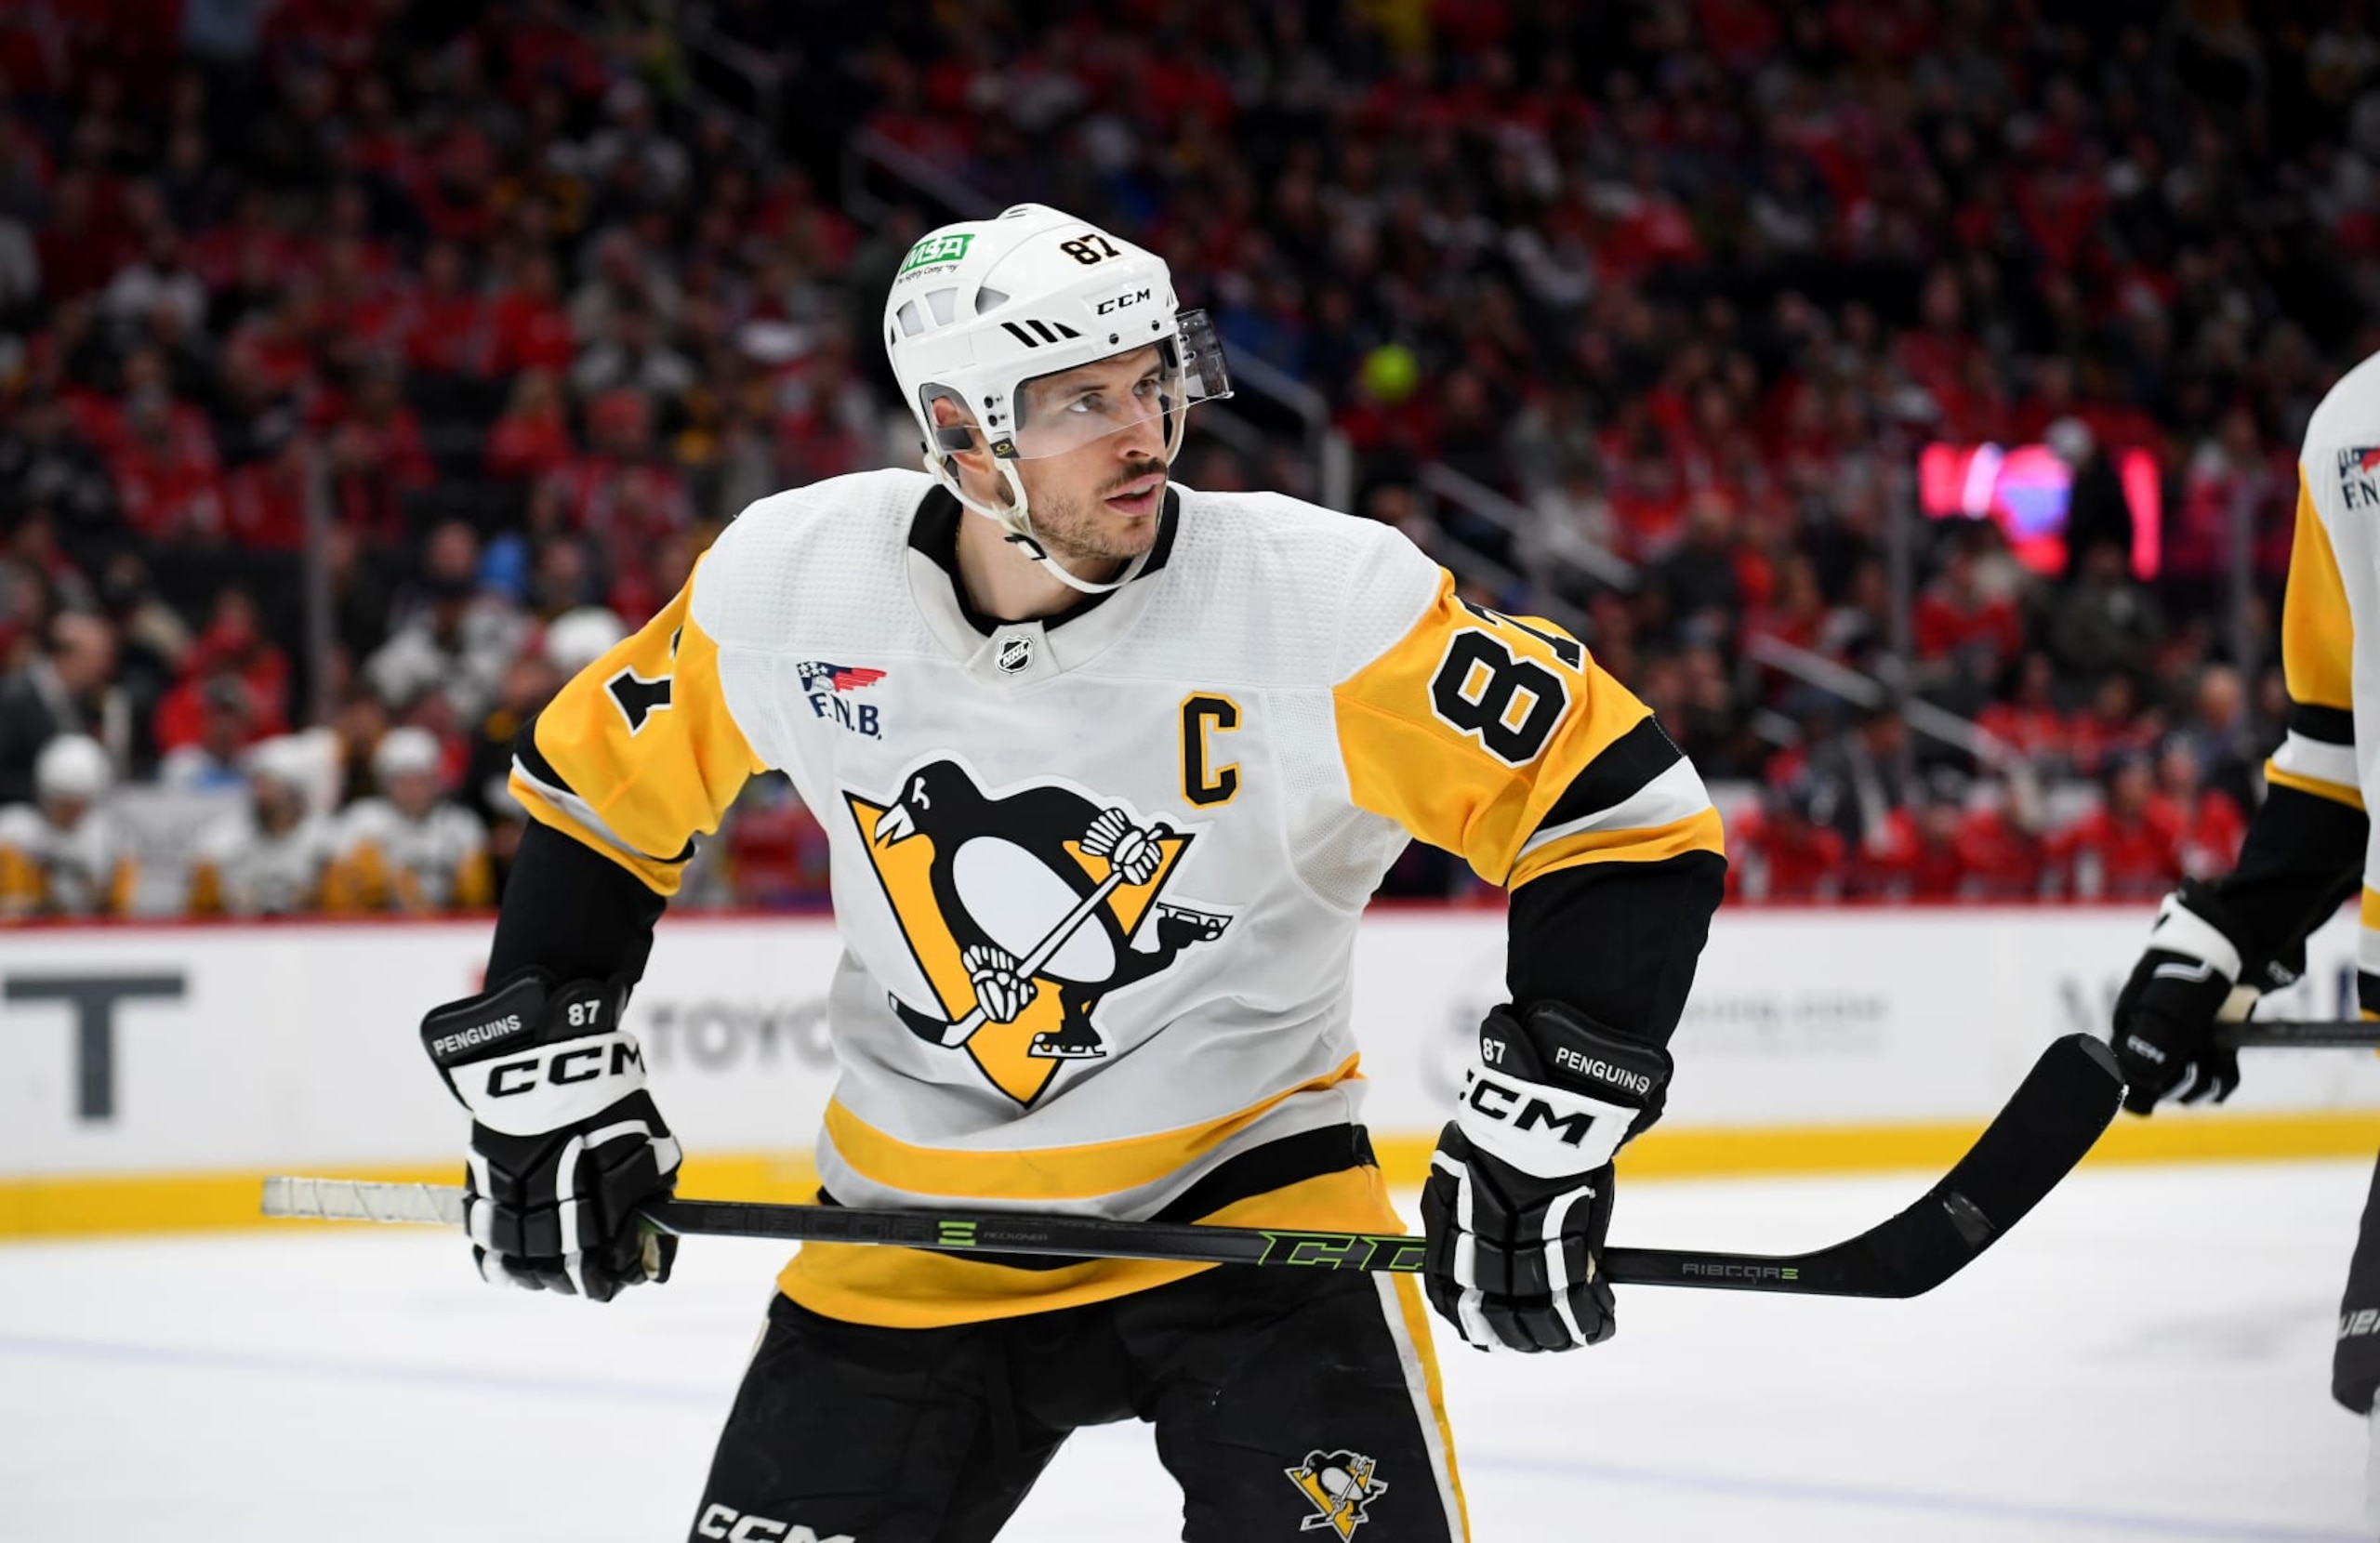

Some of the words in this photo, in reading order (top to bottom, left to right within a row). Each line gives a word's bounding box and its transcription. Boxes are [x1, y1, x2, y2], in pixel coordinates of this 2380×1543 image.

[900, 235, 968, 271] MSA
[1060, 233, 1121, 265] 87
[1097, 287, 1151, 316] CCM
[1002, 643, 1028, 666] NHL
[807, 692, 882, 741] F.N.B.
[1179, 691, 1242, 811] C
[568, 999, 602, 1027] 87
[432, 1014, 522, 1057] PENGUINS
[1482, 1037, 1506, 1064] 87
[486, 1041, 647, 1099] CCM
[1555, 1046, 1651, 1095] PENGUINS
[1460, 1068, 1596, 1149] CM
[1258, 1230, 1426, 1272] CC
